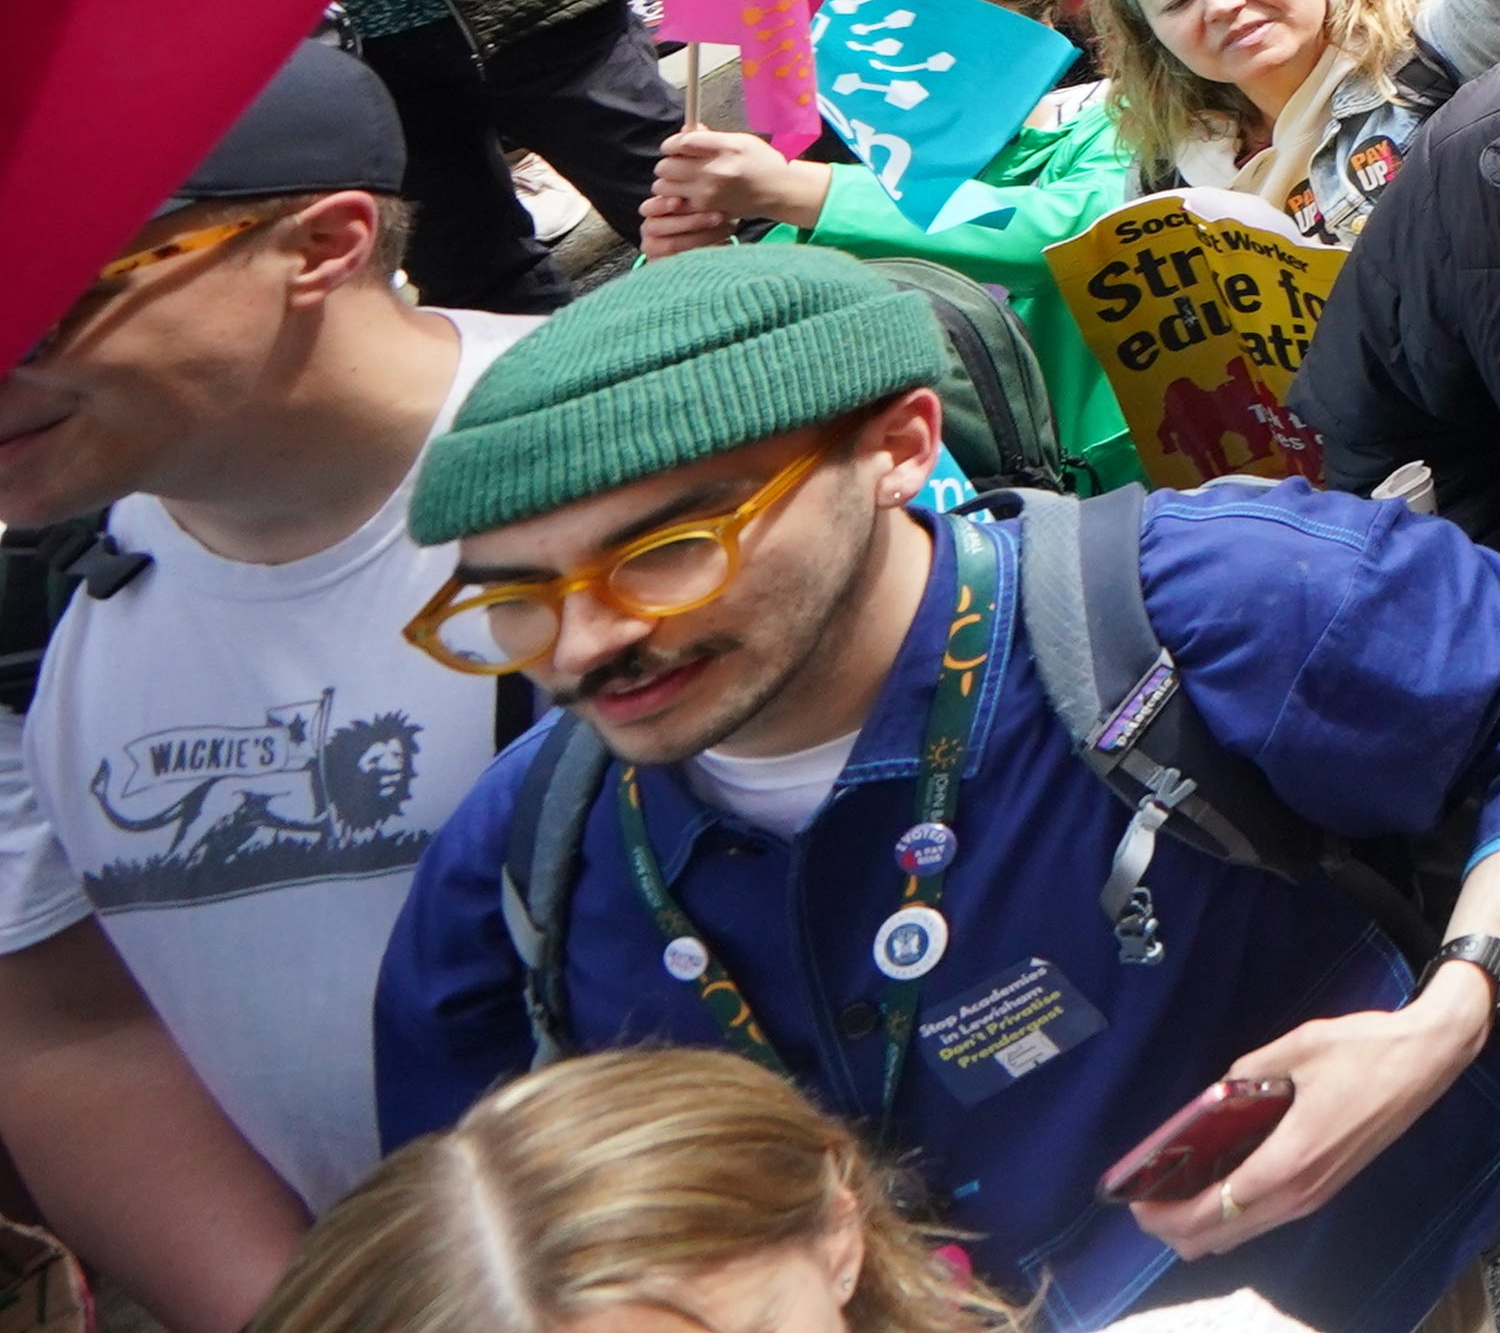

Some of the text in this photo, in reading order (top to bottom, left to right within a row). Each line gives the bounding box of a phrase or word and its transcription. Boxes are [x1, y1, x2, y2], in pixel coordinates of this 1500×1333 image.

[1350, 139, 1390, 172] PAY
[1287, 187, 1317, 212] PA
[1224, 229, 1310, 274] Worker
[149, 735, 277, 778] WACKIE'S
[919, 966, 1048, 1039] Stop Academies
[938, 989, 1062, 1061] Don't Privatise
[939, 985, 1044, 1045] in Lewisham
[957, 1004, 1065, 1068] Prendergast
